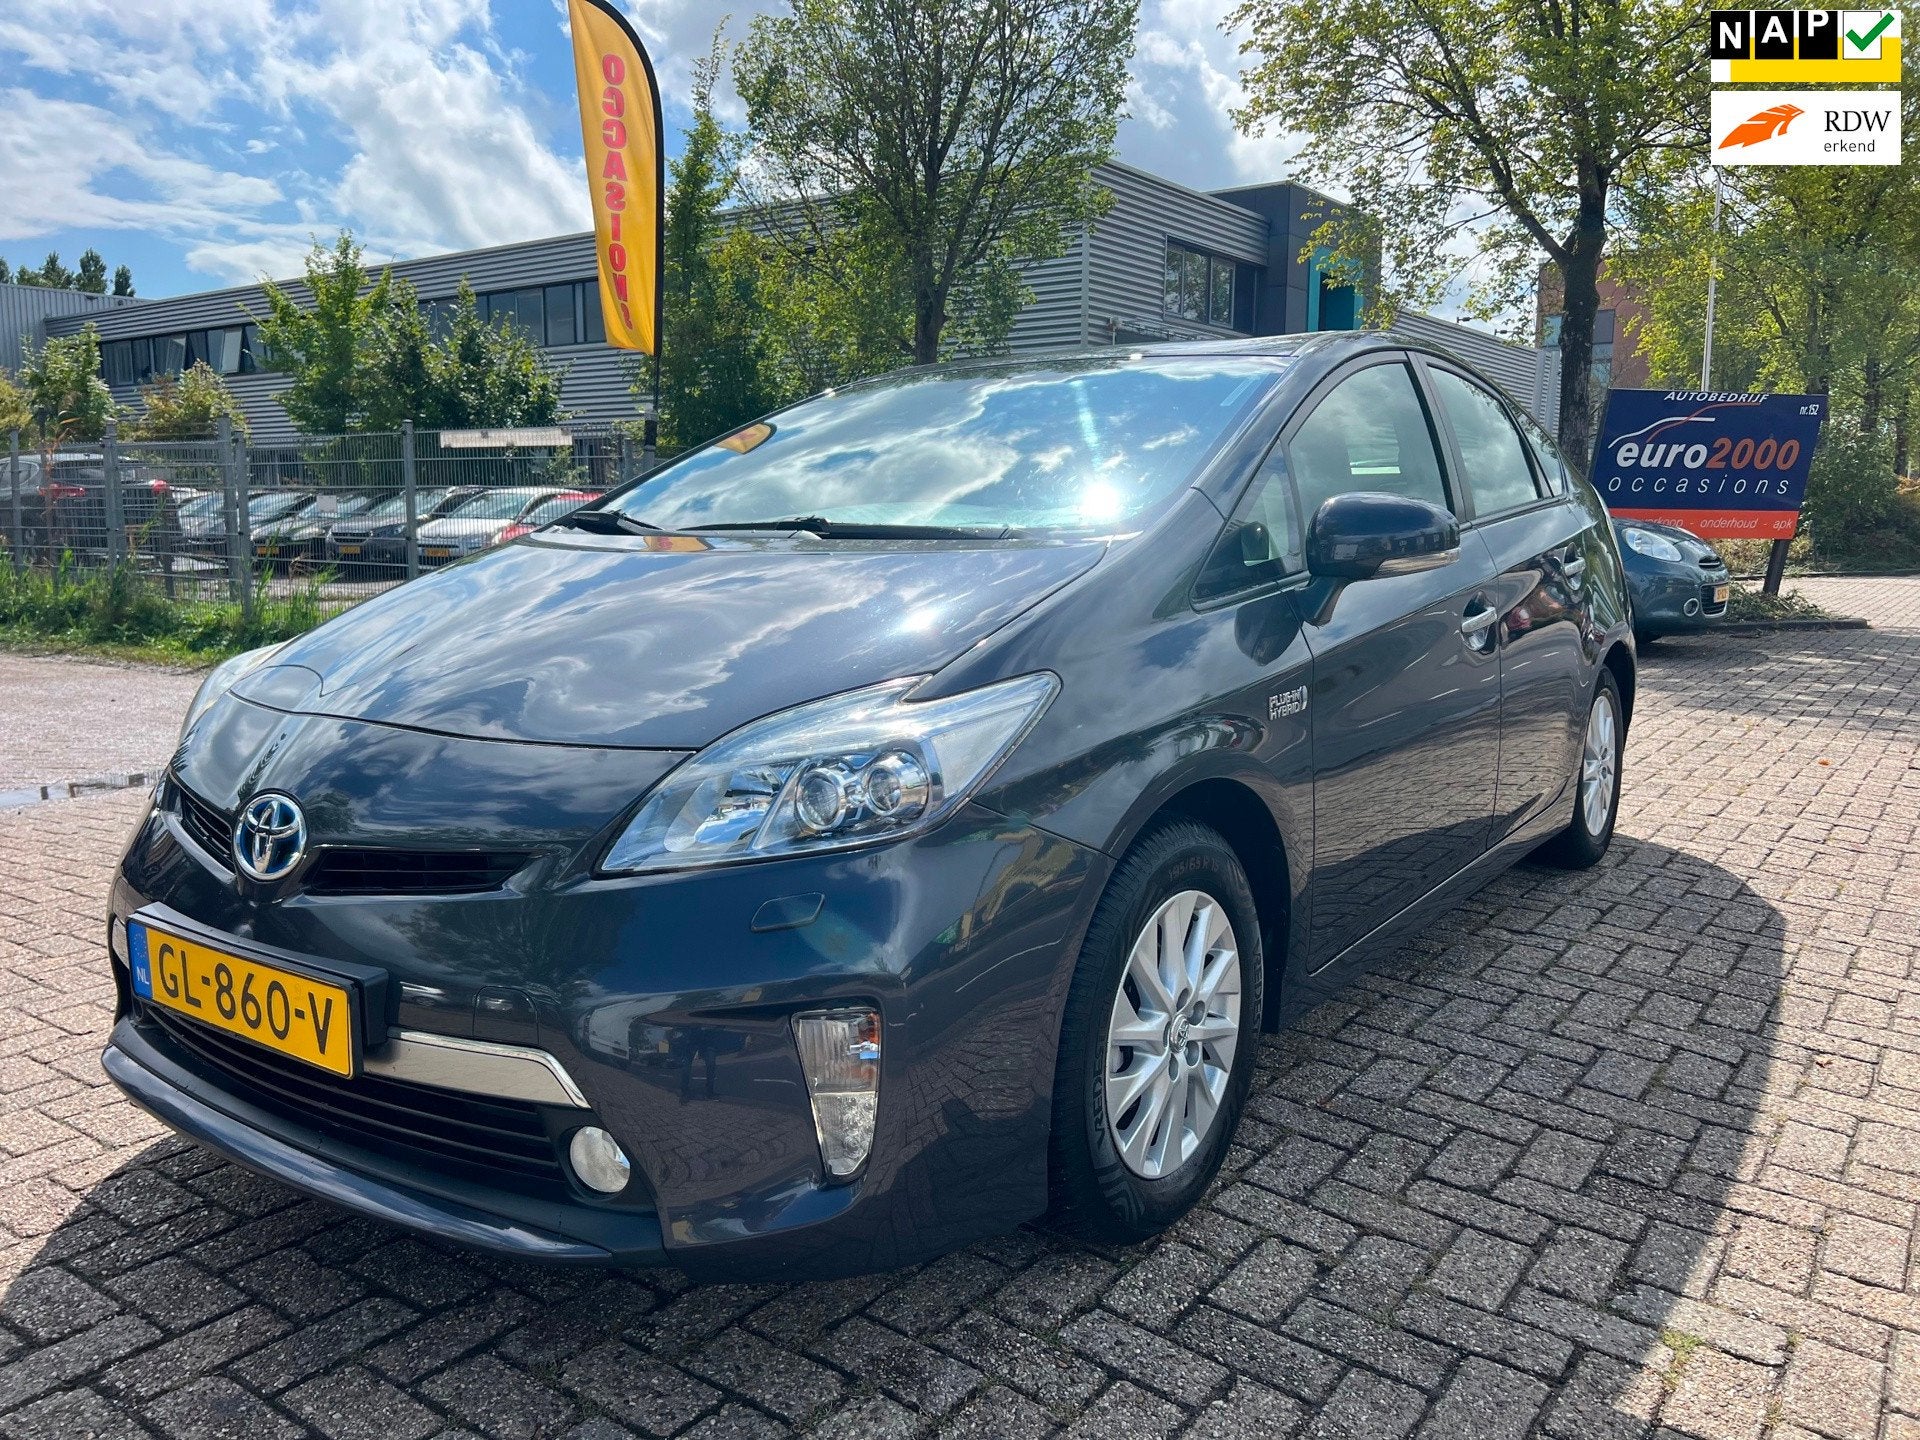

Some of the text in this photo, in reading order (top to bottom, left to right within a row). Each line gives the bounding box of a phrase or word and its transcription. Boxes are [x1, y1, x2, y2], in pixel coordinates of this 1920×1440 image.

[1664, 391, 1769, 403] AUTOBEDRIJF
[1616, 437, 1800, 471] euro2000
[1608, 474, 1789, 494] occasions
[1700, 518, 1758, 528] onderhoud
[1772, 520, 1792, 531] apk
[1270, 701, 1300, 720] HYBRID
[136, 966, 150, 985] NL
[158, 943, 333, 1055] GL-860-V
